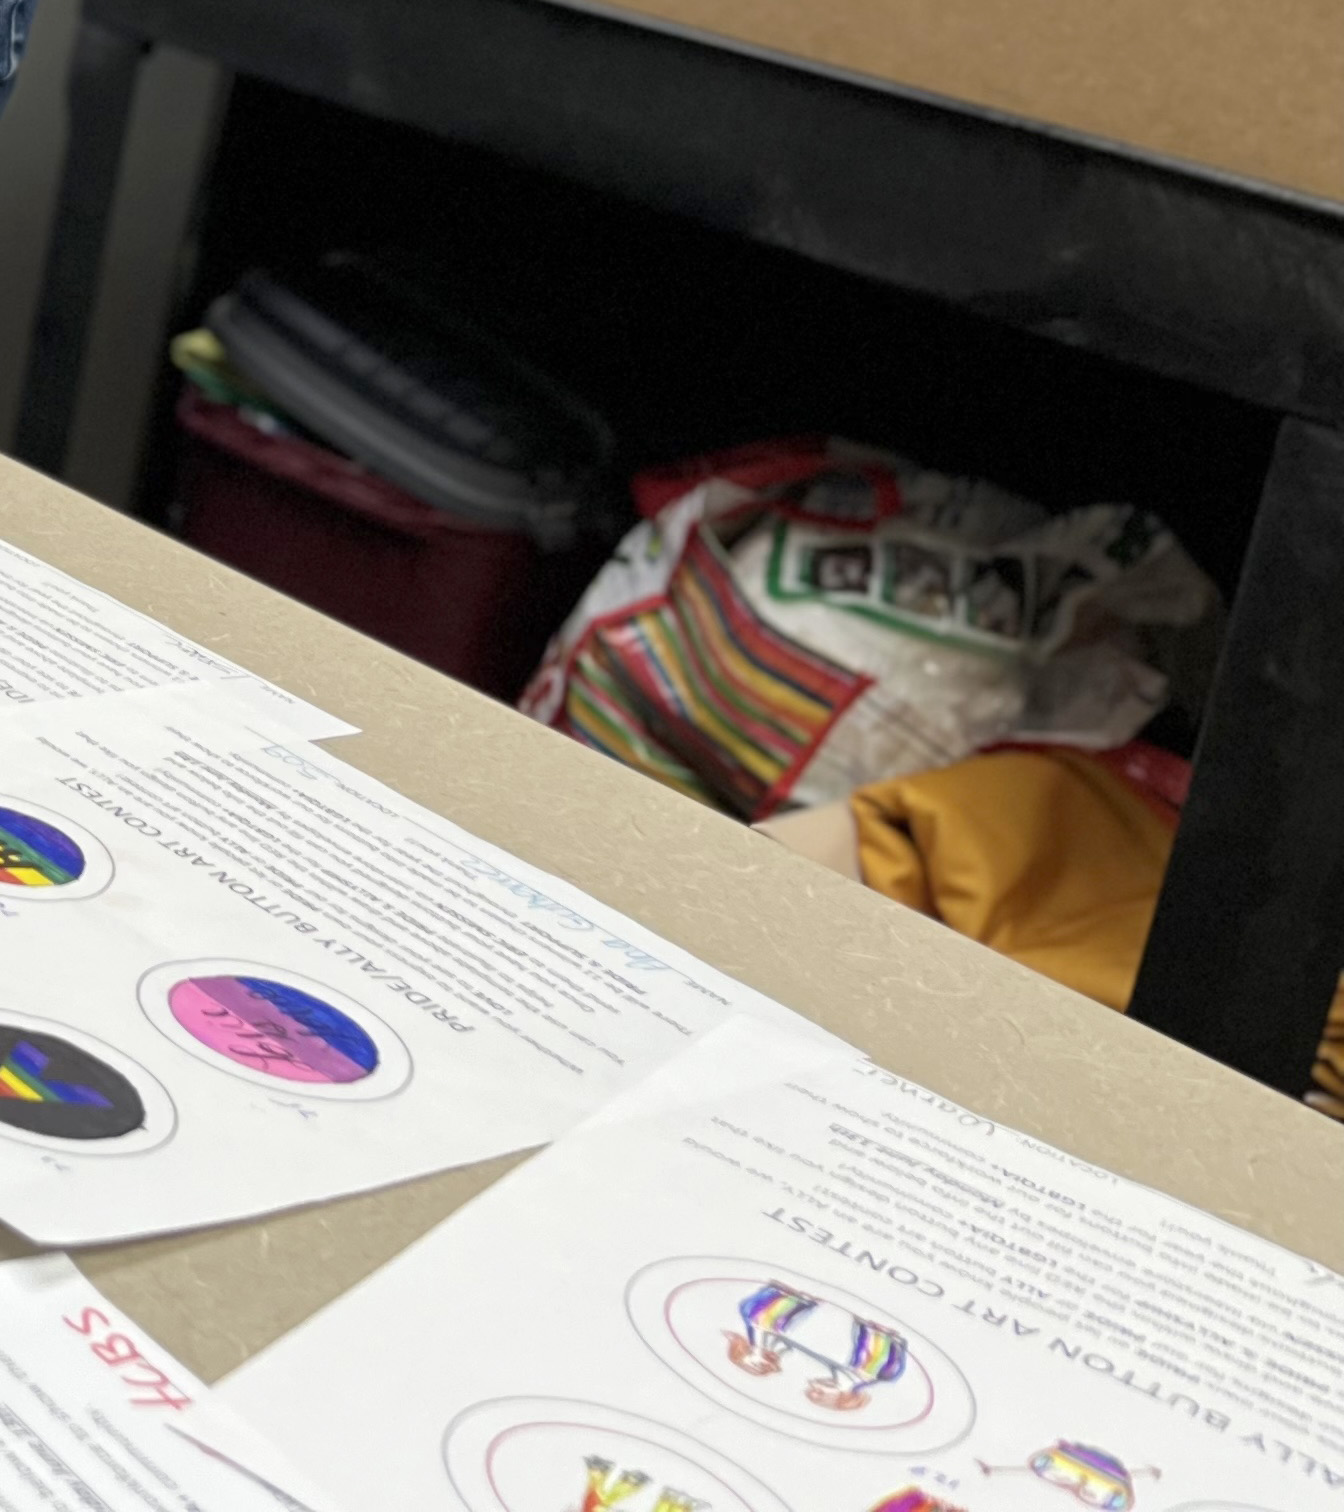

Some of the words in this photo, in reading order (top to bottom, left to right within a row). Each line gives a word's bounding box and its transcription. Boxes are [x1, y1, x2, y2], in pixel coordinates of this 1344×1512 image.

[52, 774, 166, 837] CONTEST
[154, 837, 215, 869] ART
[205, 869, 321, 935] BUTTON
[308, 933, 482, 1034] PRIDE/ALLY
[759, 1201, 948, 1302] CONTEST
[952, 1293, 1042, 1346] ART
[1046, 1334, 1232, 1432] BUTTON
